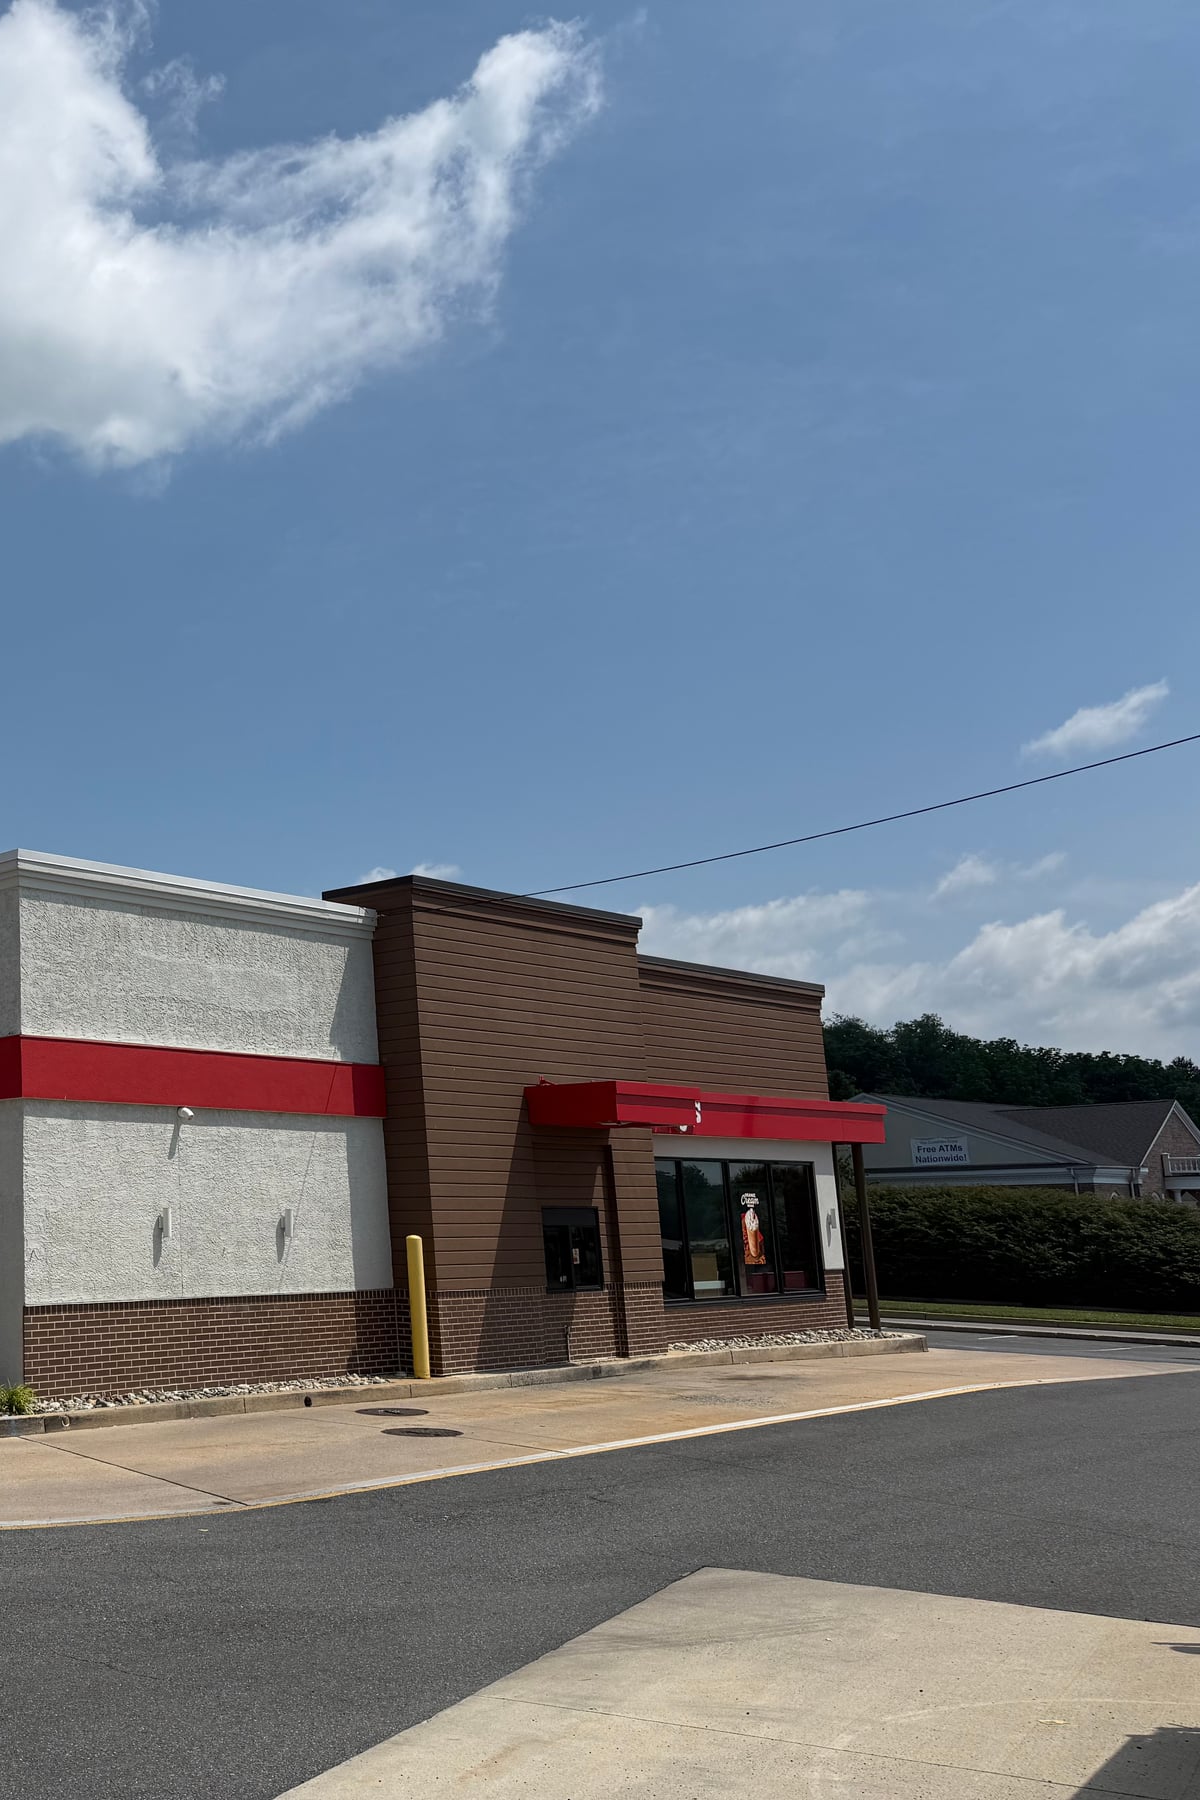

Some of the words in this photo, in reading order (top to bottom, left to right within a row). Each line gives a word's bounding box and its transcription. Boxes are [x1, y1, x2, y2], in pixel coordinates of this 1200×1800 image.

[917, 1145, 937, 1153] Free
[938, 1144, 963, 1152] ATMs
[915, 1153, 967, 1163] Nationwide!
